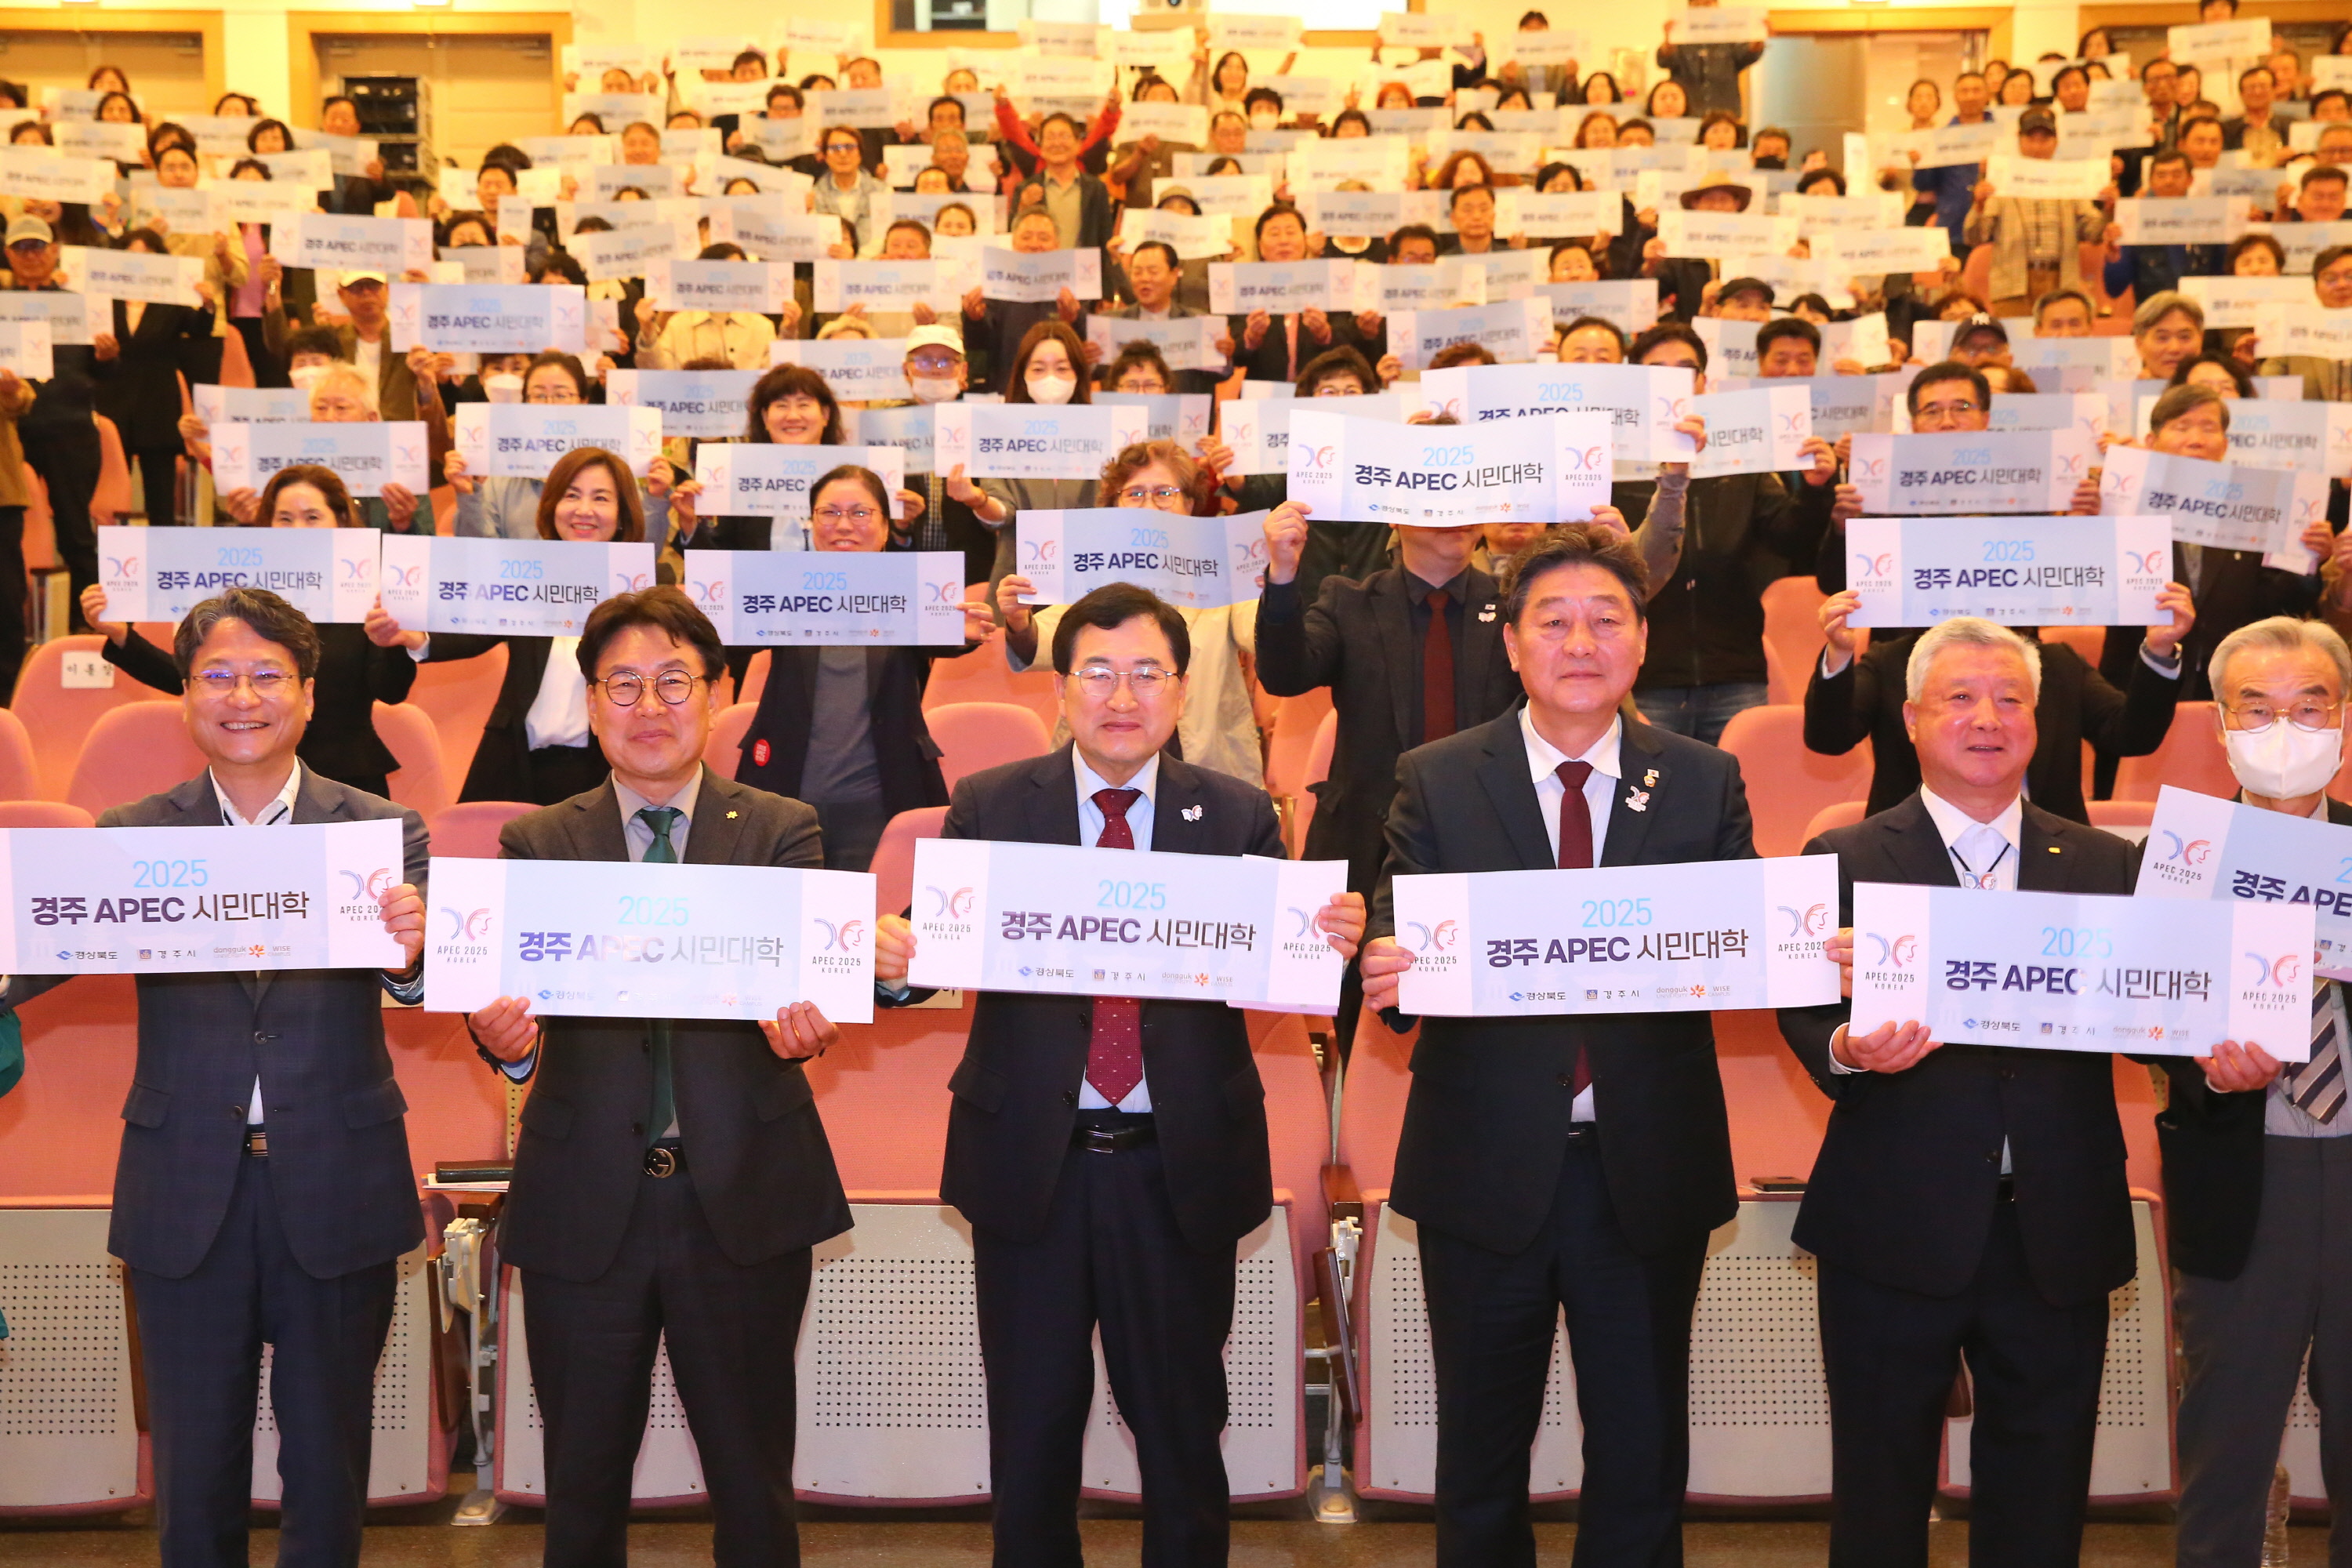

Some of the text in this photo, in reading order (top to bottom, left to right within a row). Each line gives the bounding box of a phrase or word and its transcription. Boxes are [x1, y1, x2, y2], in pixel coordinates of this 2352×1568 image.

[453, 316, 490, 328] APEC
[830, 367, 862, 379] APEC
[1538, 383, 1584, 402] 2025
[669, 401, 704, 413] APEC
[543, 419, 576, 434] 2025
[1024, 420, 1058, 435] 2025
[497, 437, 565, 452] 경주 APEC
[979, 437, 1102, 454] 경주 APEC 시민대학
[1423, 445, 1475, 467] 2025
[1952, 449, 1991, 466] 2025
[783, 459, 816, 474] 2025
[739, 477, 805, 492] 경주 APEC
[1354, 463, 1544, 492] 경주 APEC 시민대학
[1900, 467, 2041, 488] 경주 APEC 시민대학
[2205, 479, 2243, 499] 2025
[2148, 491, 2177, 510] 경주
[2180, 497, 2228, 518] APEC
[1131, 528, 1169, 549] 2025
[217, 548, 263, 567] 2025
[1983, 540, 2035, 561] 2025
[500, 560, 543, 579] 2025
[1073, 553, 1218, 577] 경주 APEC 시민대학
[157, 571, 322, 590] 경주 APEC 시민대학
[803, 572, 848, 590] 2025
[1914, 567, 2105, 590] 경주 APEC 시민대학
[439, 582, 599, 604] 경주 APEC 시민대학
[743, 595, 907, 614] 경주 APEC 시민대학
[133, 859, 209, 887] 2025
[2154, 862, 2202, 880] APEC 2025
[2161, 873, 2190, 884] KOREA
[1097, 879, 1166, 910] 2025
[2233, 869, 2286, 903] 경주
[31, 891, 310, 925] 경주 APEC 시민대학
[340, 906, 363, 914] APEC
[618, 895, 689, 927] 2025
[1582, 898, 1652, 927] 2025
[923, 922, 971, 933] APEC 2025
[1001, 910, 1257, 951] 경주 APEC 시민대학
[213, 946, 246, 955] dongguk
[437, 946, 488, 955] APEC 2025
[519, 931, 784, 967] 경주 APEC 시민대학
[1283, 942, 1331, 953] APEC 2025
[1487, 928, 1748, 968] 경주 APEC 시민대학
[1778, 943, 1800, 953] APEC
[2042, 927, 2113, 958] 2025
[74, 950, 118, 960] 경상북도
[812, 956, 861, 966] APEC 2025
[1435, 956, 1457, 964] 2025
[1036, 967, 1074, 978] 경상북도
[1162, 972, 1192, 981] dongguk
[1865, 972, 1915, 983] APEC 2025
[1946, 960, 2212, 1002] 경주 APEC 시민대학
[1526, 992, 1566, 1001] 경상북도
[1603, 989, 1639, 999] 경주시
[1657, 985, 1687, 995] dongguk
[2242, 991, 2296, 1004] APEC 2025
[1980, 1020, 2020, 1032] 경상북도
[2113, 1026, 2146, 1035] dongguk
